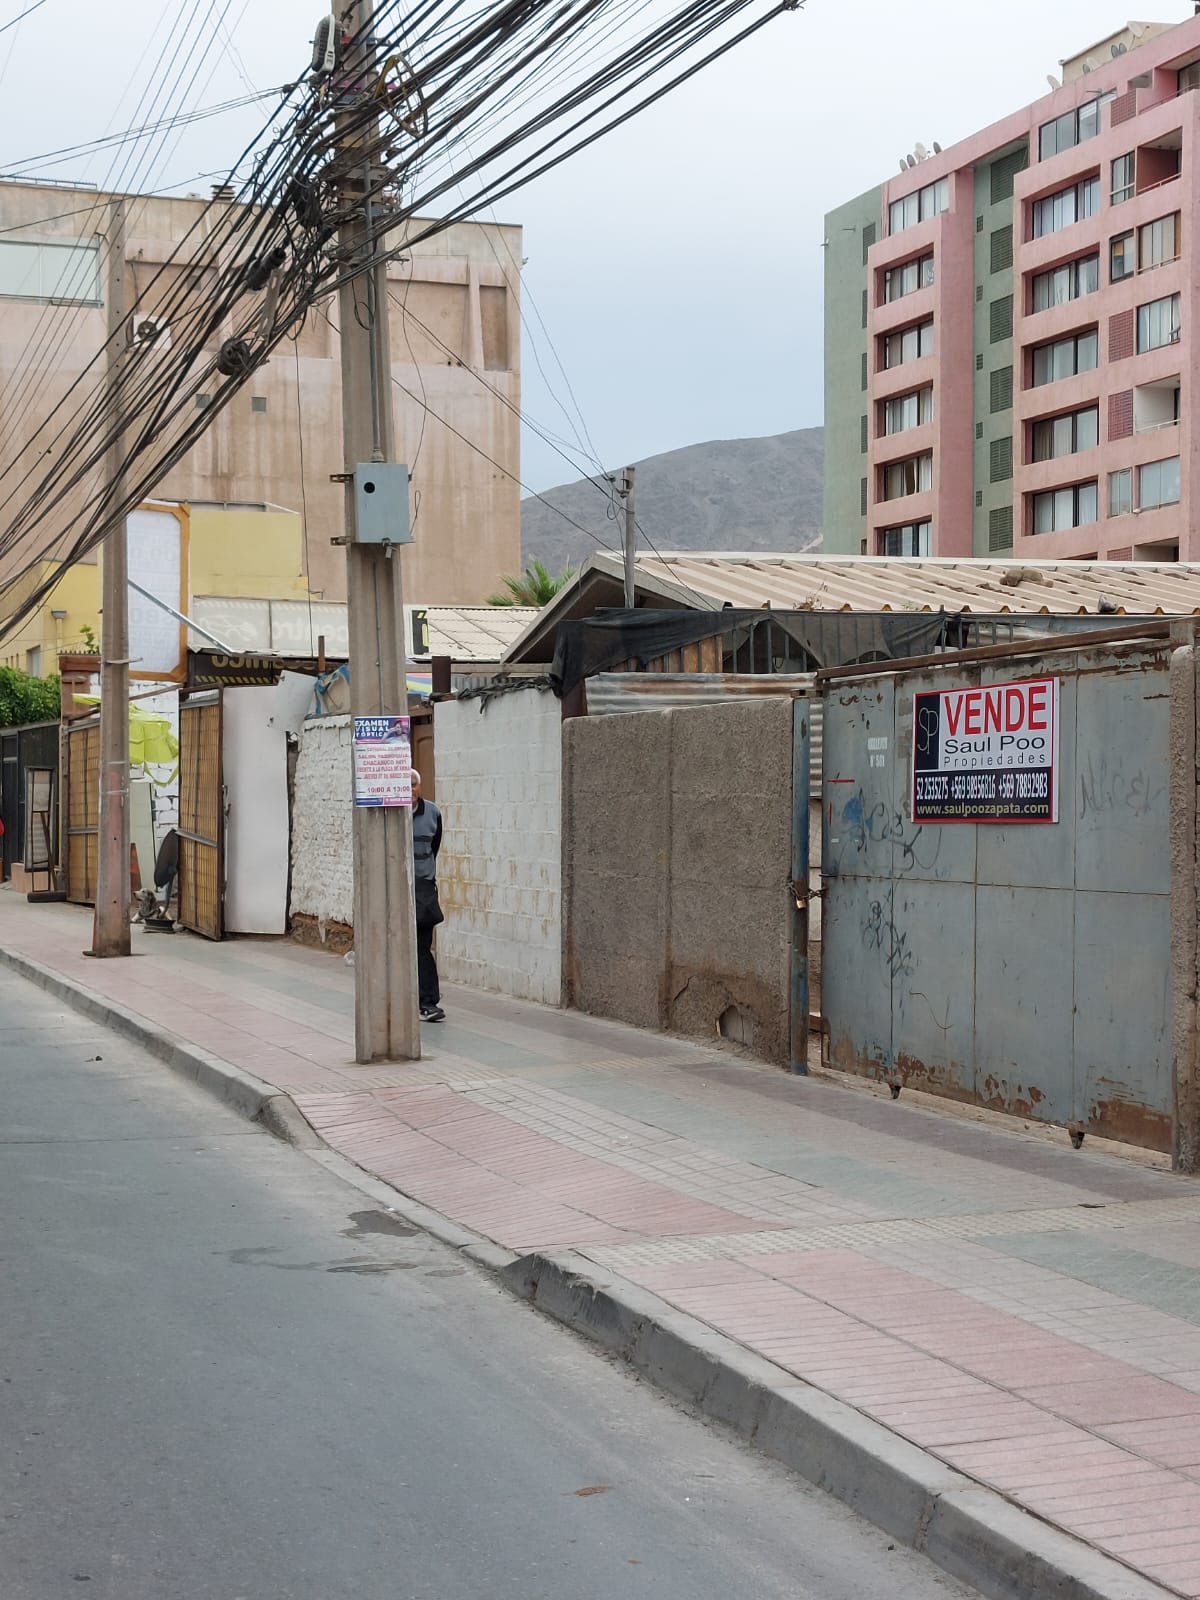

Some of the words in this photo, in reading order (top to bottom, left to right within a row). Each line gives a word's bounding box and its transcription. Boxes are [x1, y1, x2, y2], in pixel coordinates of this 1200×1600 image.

[944, 685, 1047, 736] VENDE
[944, 737, 991, 754] Saul
[1000, 735, 1046, 751] Poo
[944, 752, 1046, 769] Propiedades
[916, 777, 924, 800] 52
[924, 776, 949, 800] 2535275
[951, 775, 966, 799] +569
[966, 774, 996, 799] 98956816
[999, 773, 1014, 799] +569
[1015, 772, 1048, 798] 78892983
[916, 802, 1049, 817] www.saulpoozapata.com
